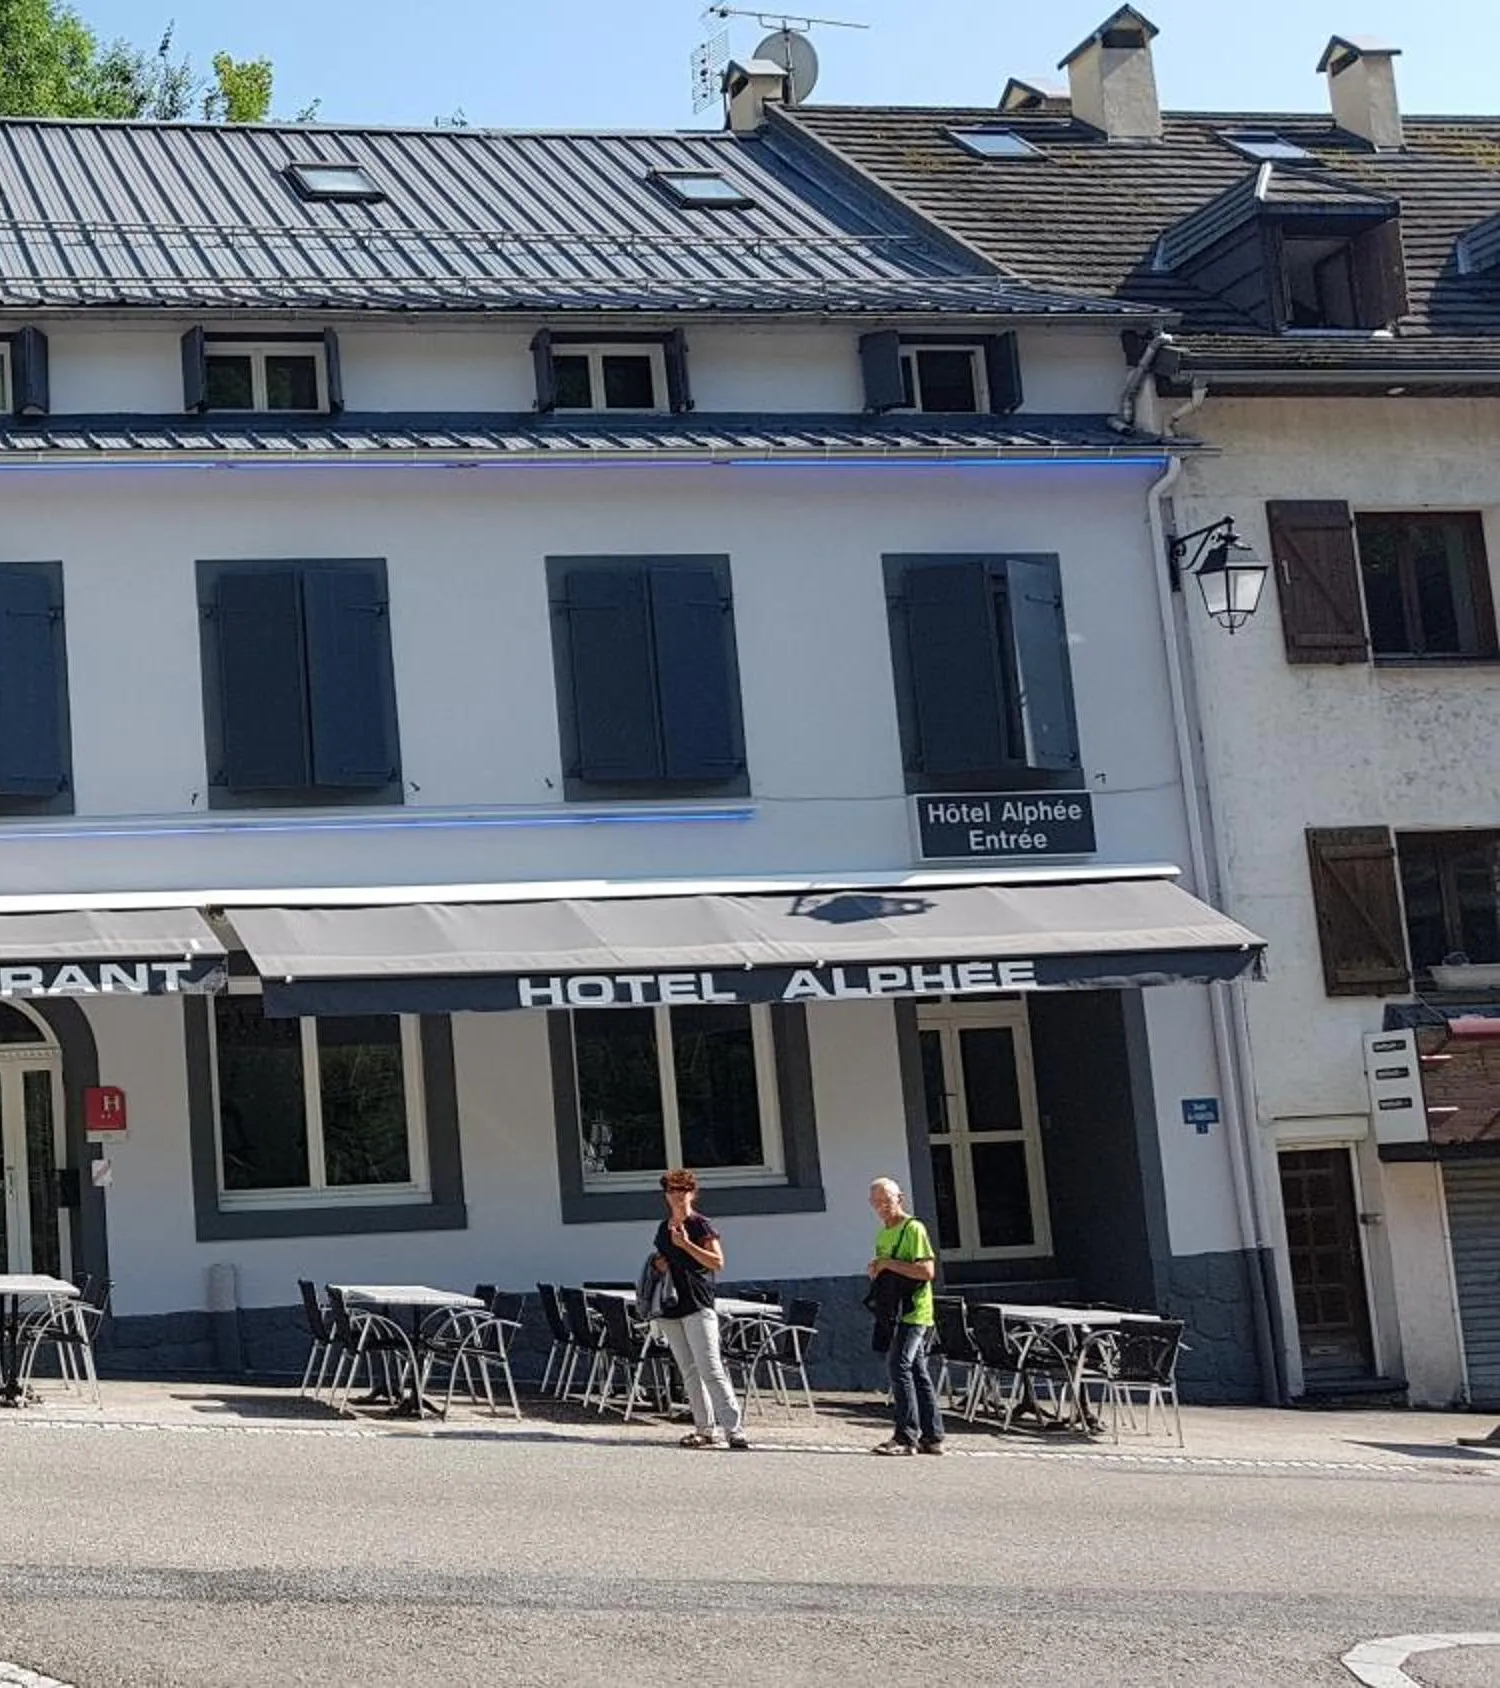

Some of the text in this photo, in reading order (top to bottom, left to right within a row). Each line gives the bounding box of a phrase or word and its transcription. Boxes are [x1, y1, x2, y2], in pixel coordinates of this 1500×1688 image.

[927, 800, 1083, 825] Hôtel Alphée
[969, 828, 1049, 851] Entrée
[517, 972, 737, 1007] HOTEL
[103, 1095, 120, 1112] H
